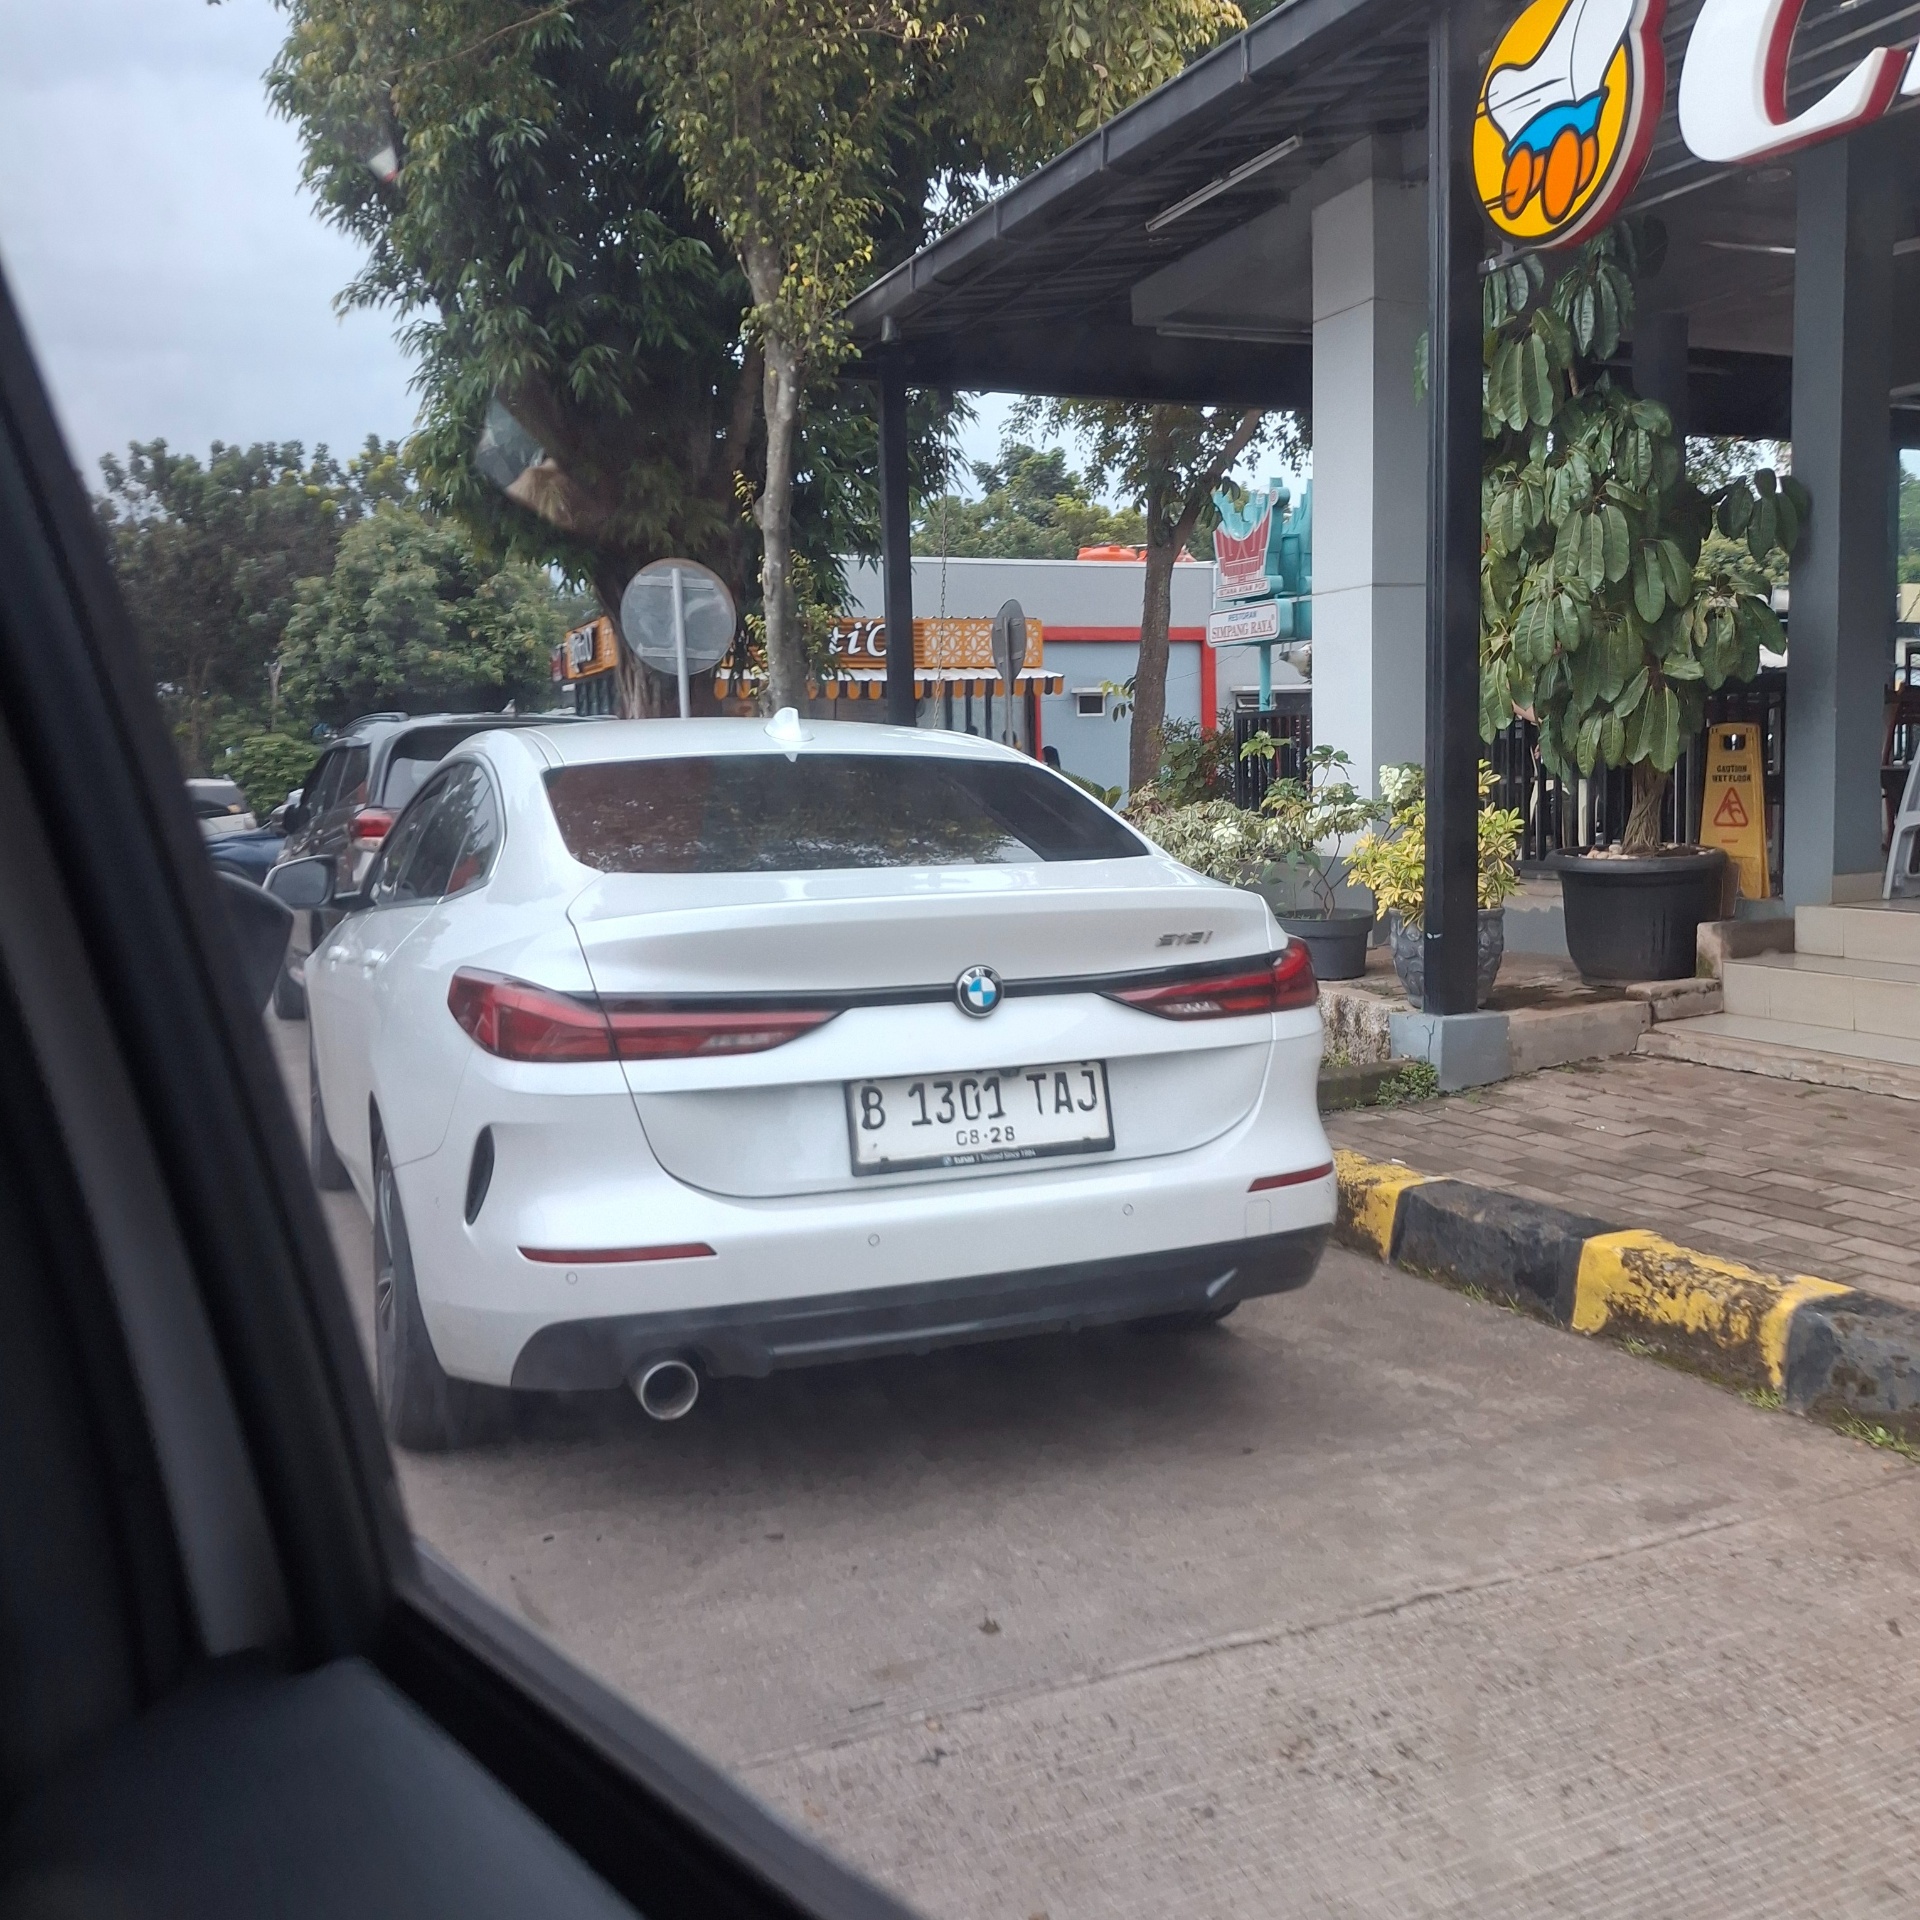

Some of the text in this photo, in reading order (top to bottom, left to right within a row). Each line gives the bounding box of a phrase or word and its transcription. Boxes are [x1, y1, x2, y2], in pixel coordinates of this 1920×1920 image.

[1211, 619, 1274, 640] SIMPANG RAYA
[1716, 764, 1748, 773] CAUTION
[1712, 774, 1751, 783] WET FLOOR
[861, 1069, 1098, 1130] B 1301 TAJ
